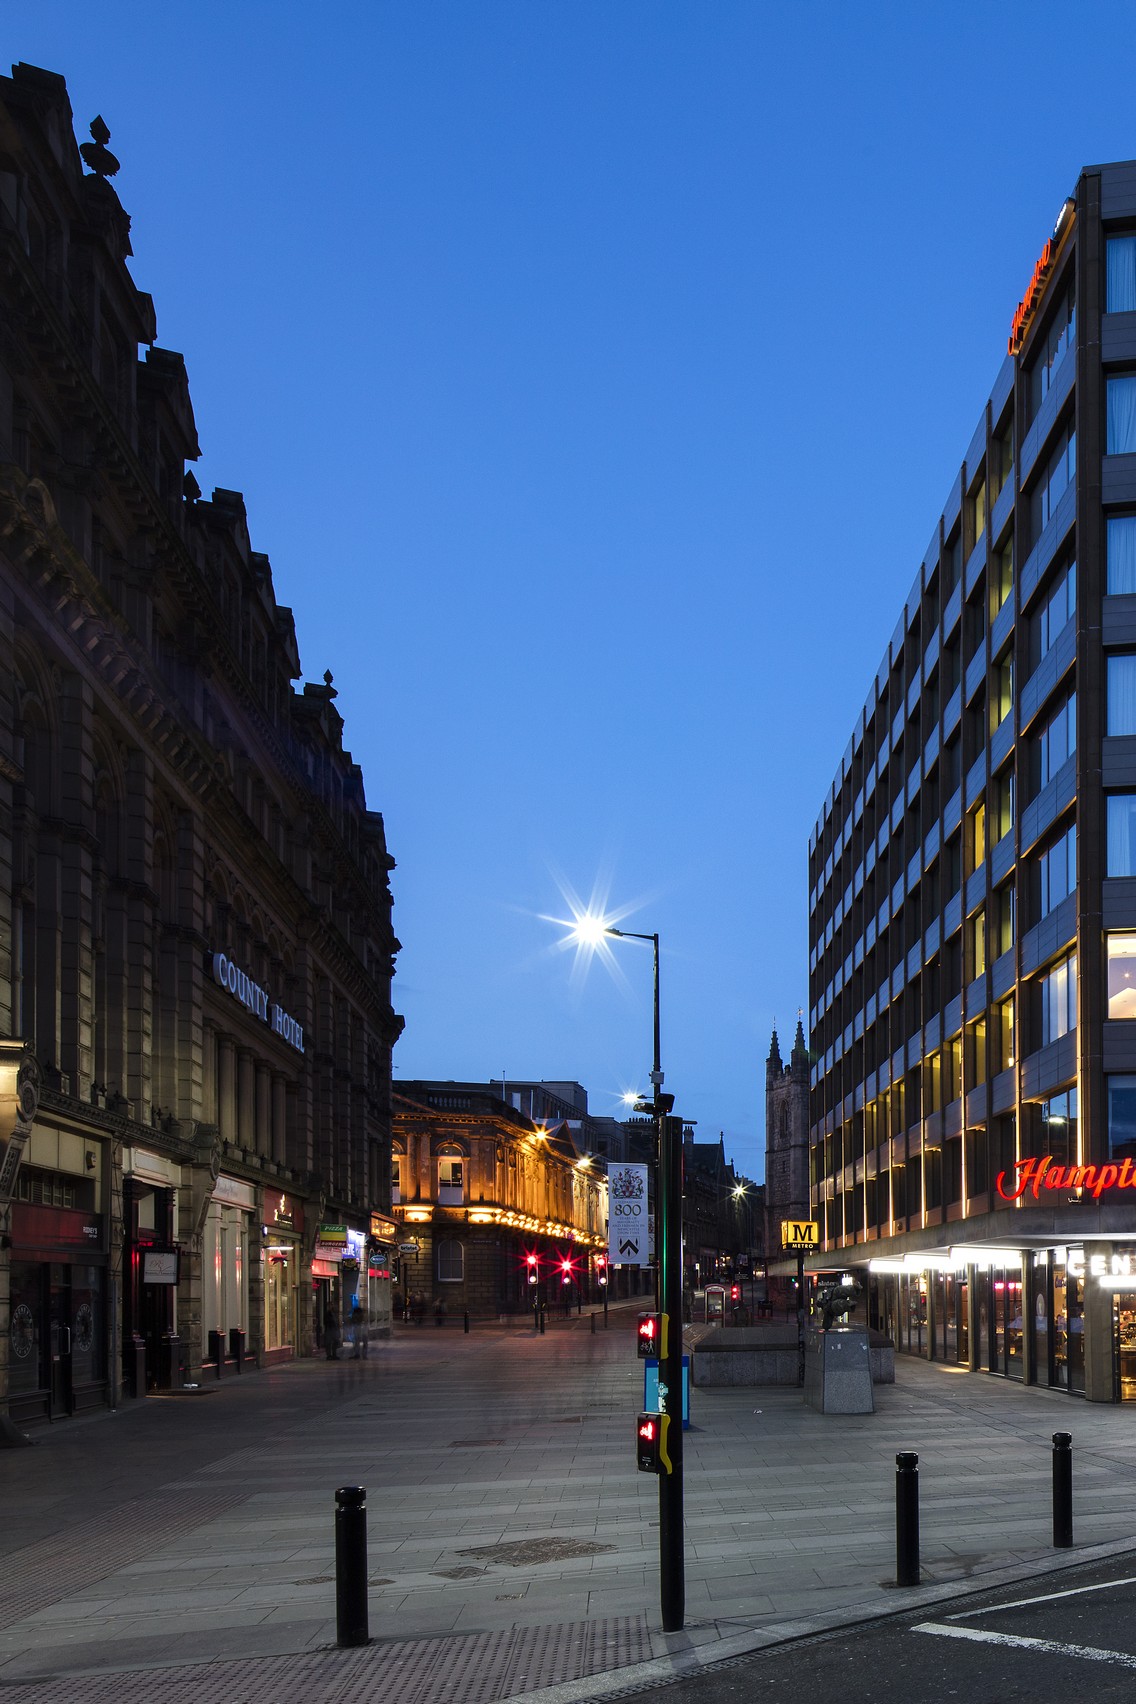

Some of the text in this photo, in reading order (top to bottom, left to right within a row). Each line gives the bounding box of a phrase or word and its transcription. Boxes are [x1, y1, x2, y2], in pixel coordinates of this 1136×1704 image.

[214, 953, 305, 1054] COUNTY HOTEL
[614, 1204, 642, 1216] 800
[793, 1225, 813, 1241] M
